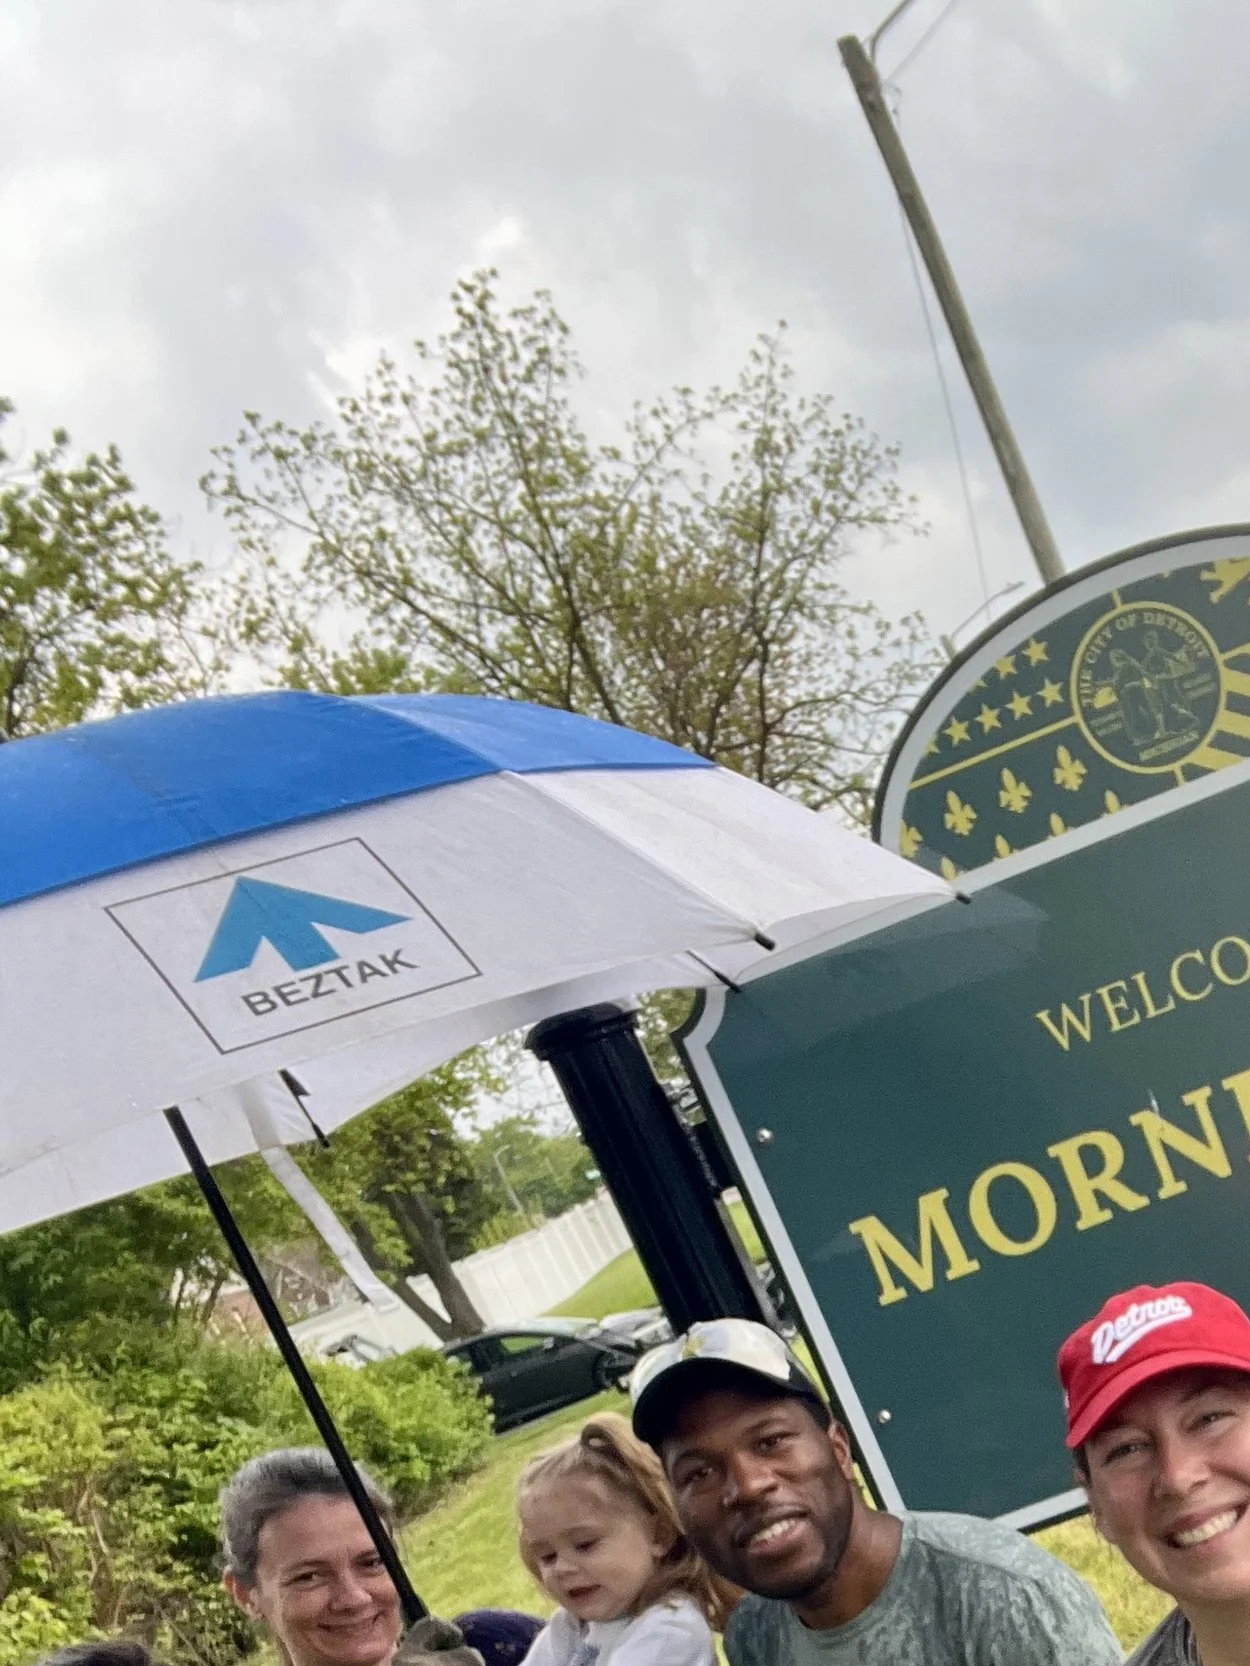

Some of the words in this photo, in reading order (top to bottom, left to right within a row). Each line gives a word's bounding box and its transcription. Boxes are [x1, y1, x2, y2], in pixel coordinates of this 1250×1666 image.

[1115, 611, 1139, 632] OF
[1142, 610, 1211, 660] DETROIT
[1084, 624, 1113, 665] CITY
[1078, 668, 1093, 708] THE
[241, 948, 419, 1017] BEZTAK
